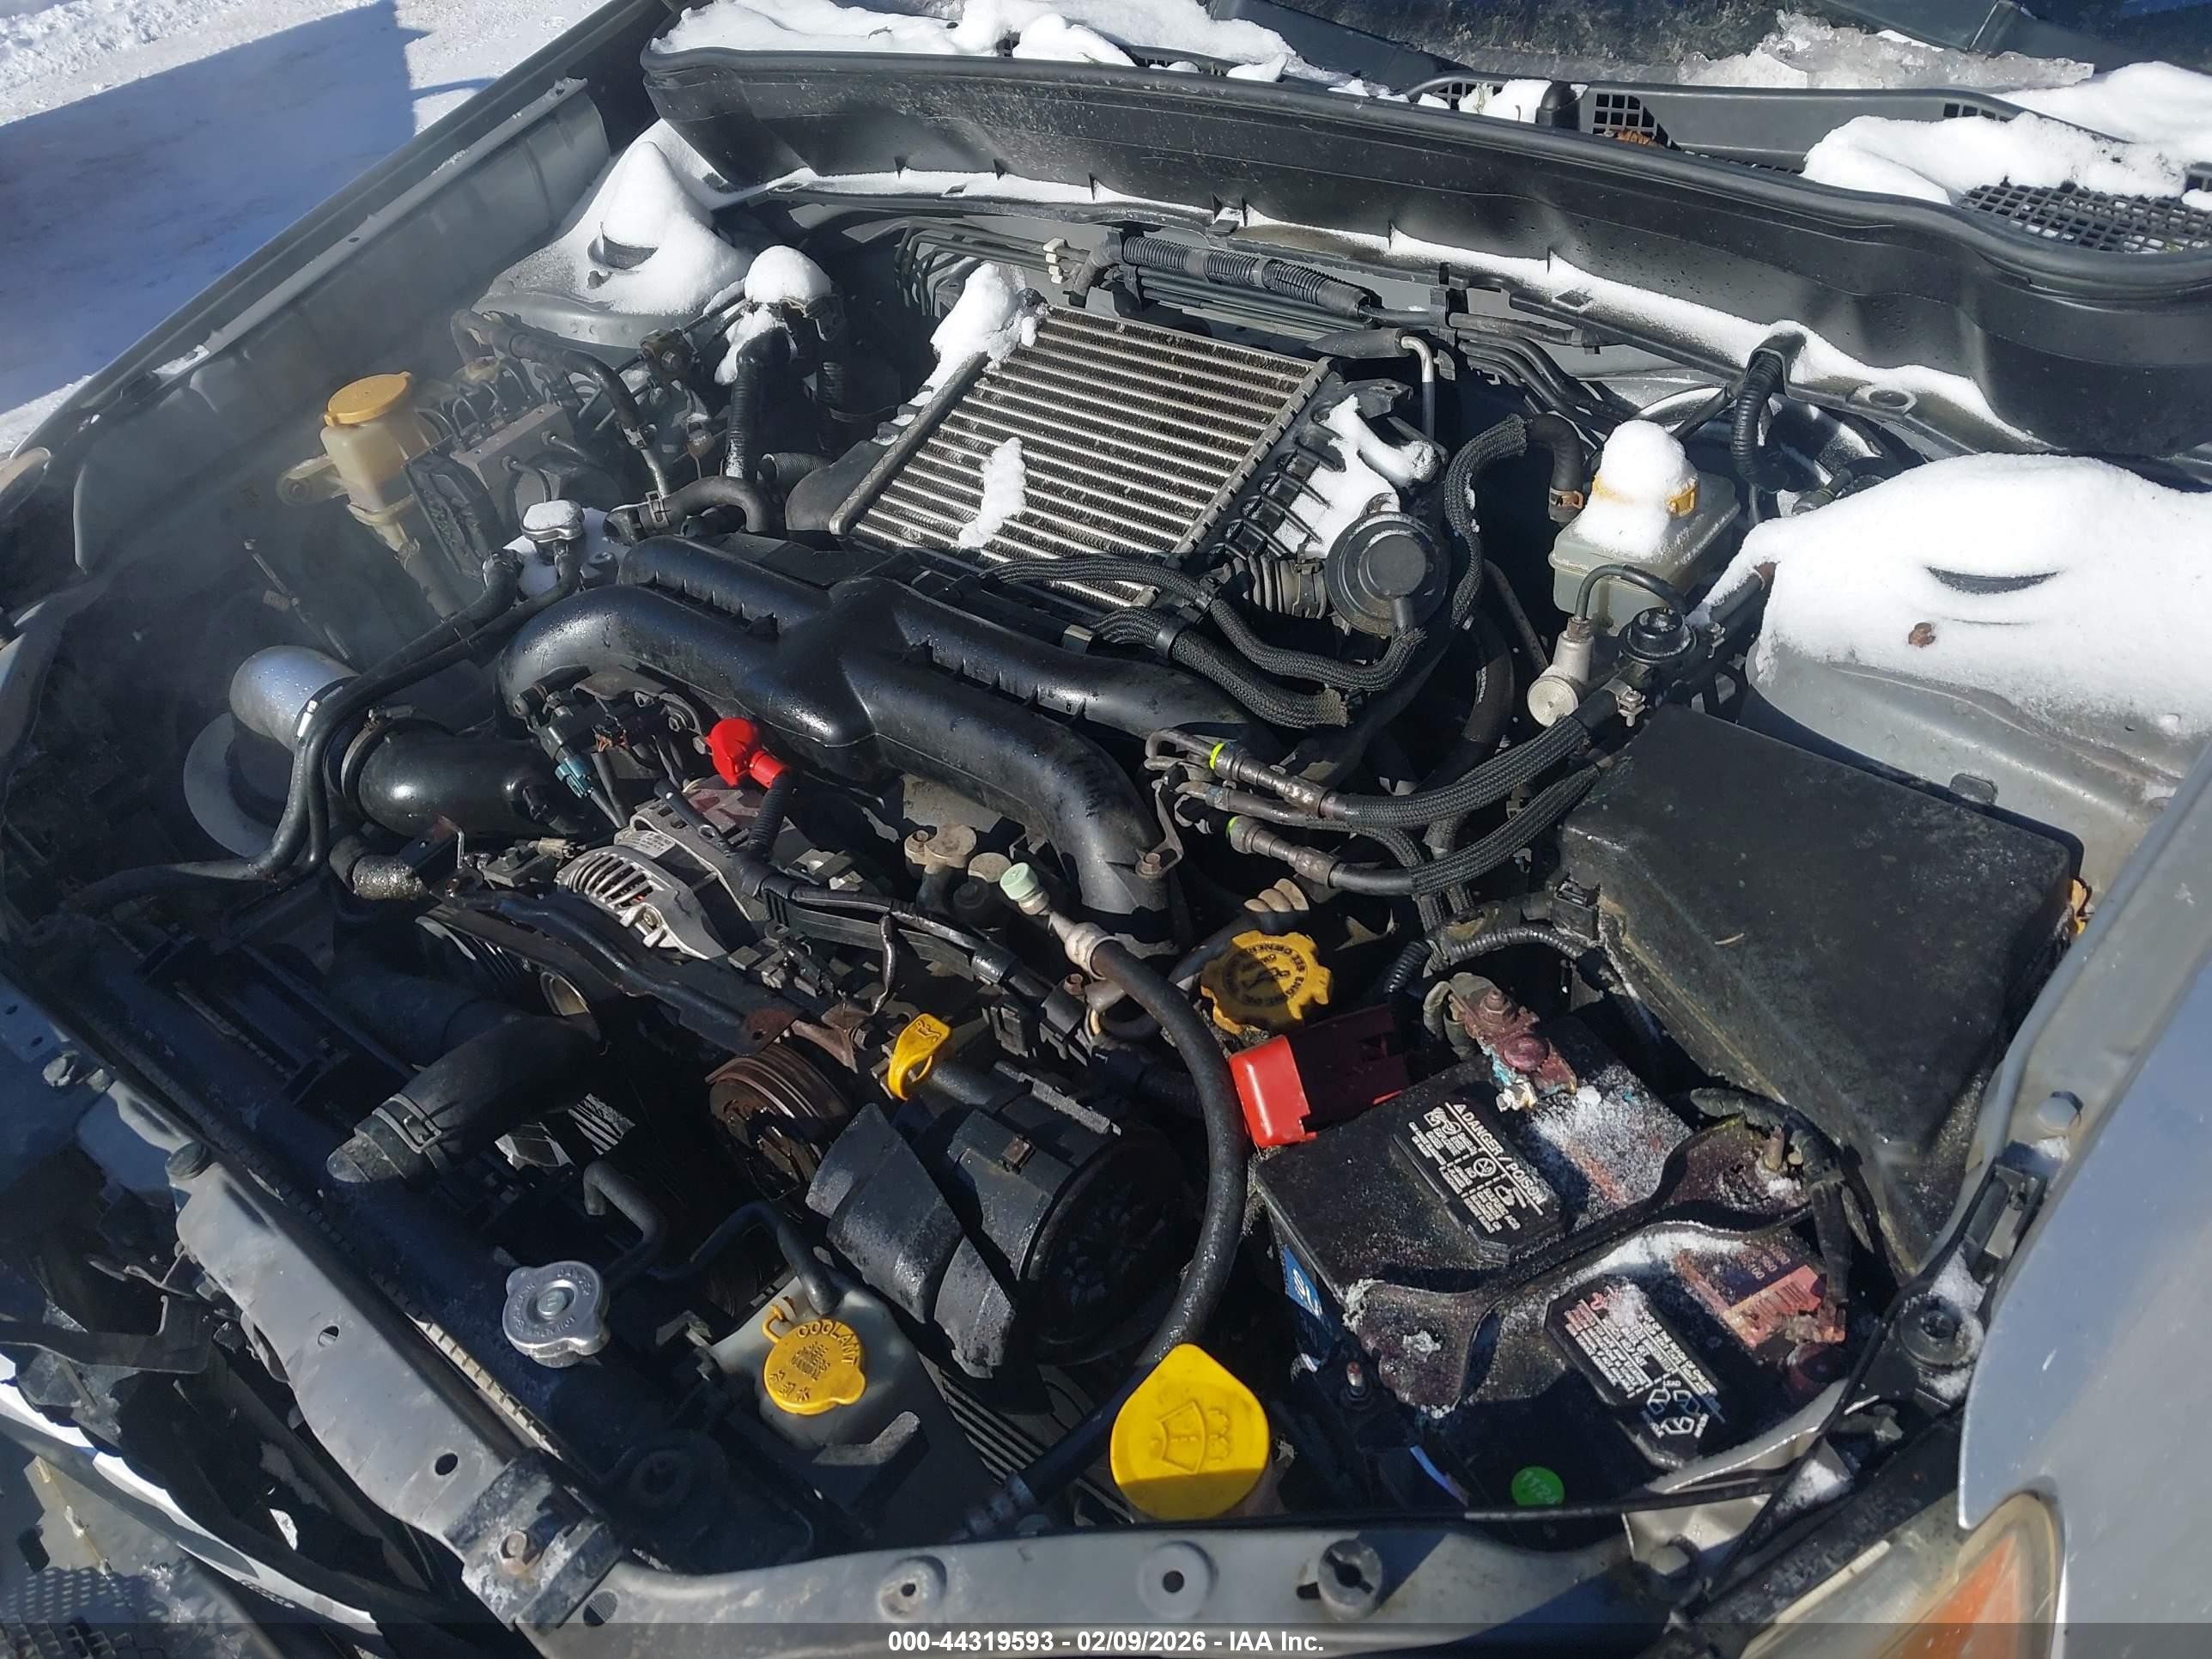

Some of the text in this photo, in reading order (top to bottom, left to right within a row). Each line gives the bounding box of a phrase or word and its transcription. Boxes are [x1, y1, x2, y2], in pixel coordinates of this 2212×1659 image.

[1461, 1111, 1504, 1155] DANGER
[1504, 1162, 1547, 1203] POISON
[797, 1320, 860, 1367] COOLANT
